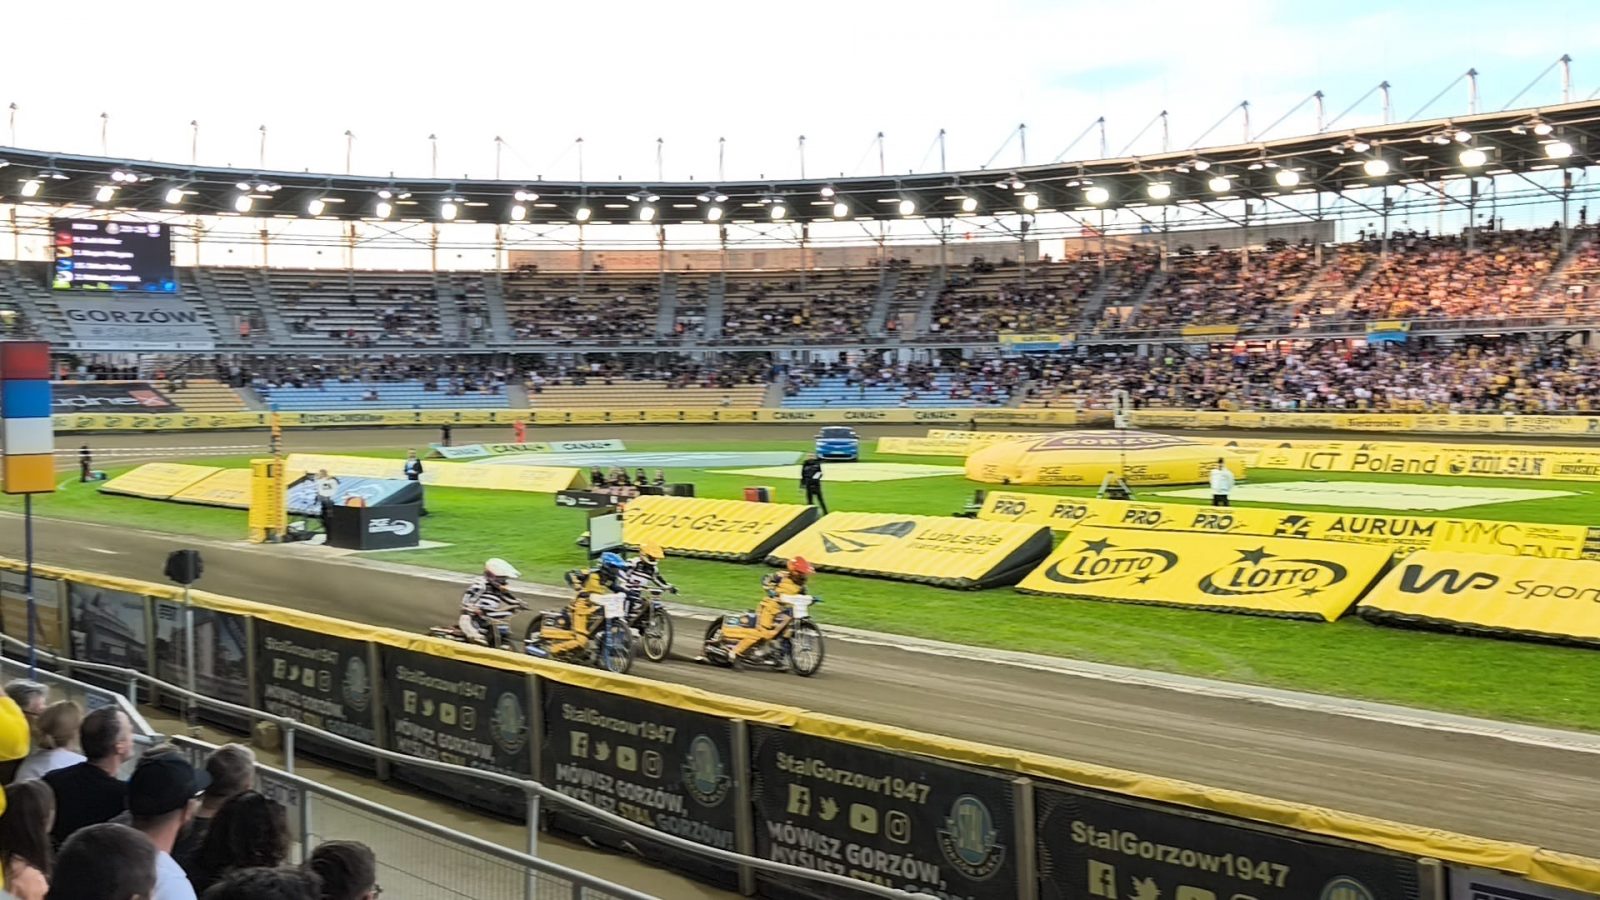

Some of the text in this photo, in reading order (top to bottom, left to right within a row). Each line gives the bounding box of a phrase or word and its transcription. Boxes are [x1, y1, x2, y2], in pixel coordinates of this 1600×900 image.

[66, 308, 198, 324] GORZÓW
[1300, 451, 1437, 475] ICT Poland
[1049, 504, 1087, 520] PRO
[1121, 509, 1162, 525] PRO
[1191, 513, 1233, 530] PRO
[1326, 516, 1438, 537] AURUM
[1072, 555, 1154, 576] LOTTO
[1233, 567, 1320, 588] LOTTO
[562, 702, 677, 744] StalGorzow1947
[776, 751, 931, 804] StalGorzow1947
[766, 820, 843, 859] MÓWISZ
[844, 842, 948, 891] GORZÓW,
[1071, 820, 1291, 888] StalGorzow1947
